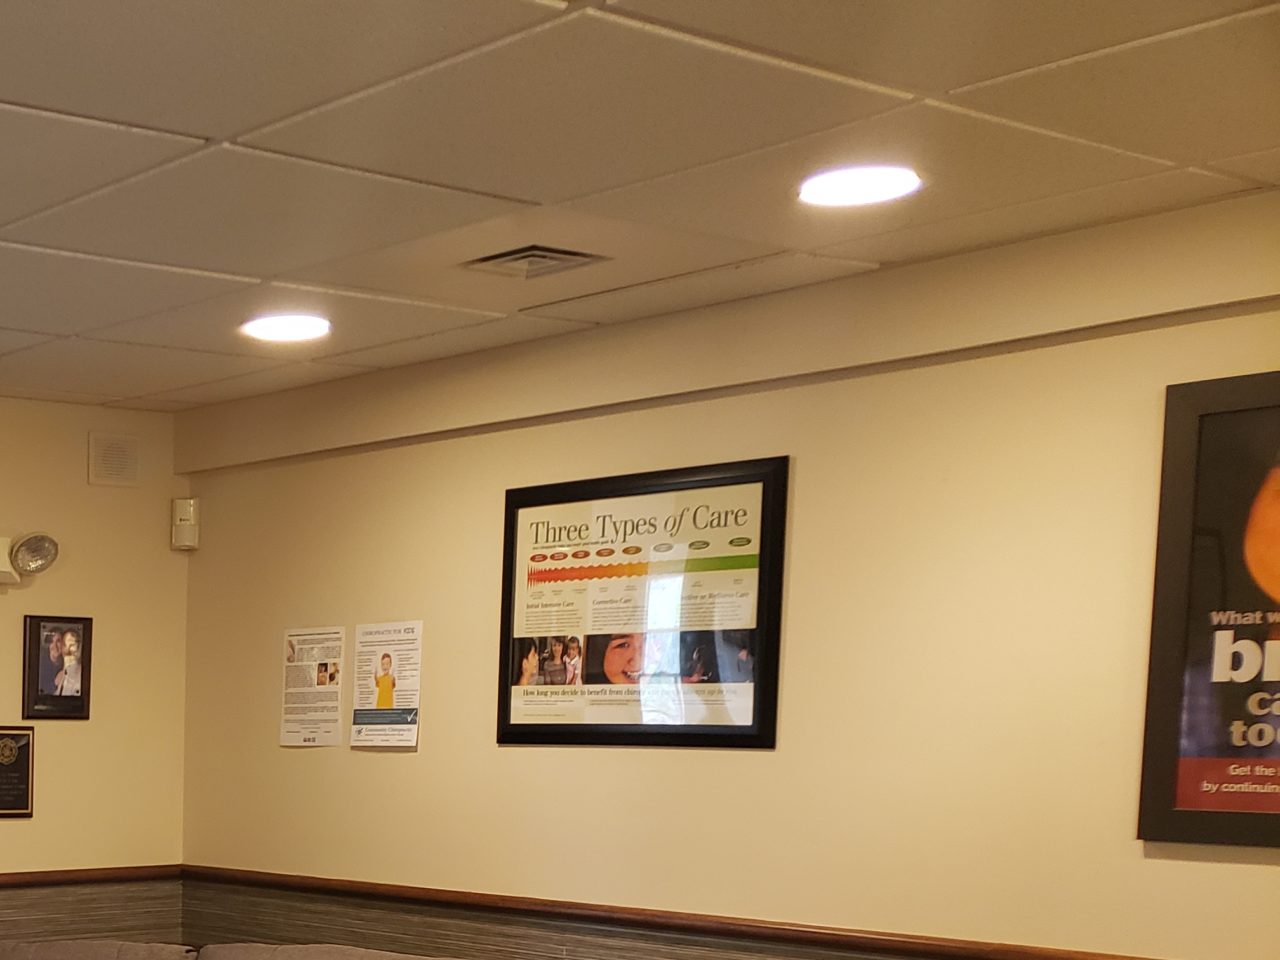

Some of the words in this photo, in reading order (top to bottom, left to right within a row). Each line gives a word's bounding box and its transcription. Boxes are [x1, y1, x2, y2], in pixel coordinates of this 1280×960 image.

[529, 520, 590, 545] Three
[596, 514, 657, 544] Types
[663, 507, 690, 537] of
[692, 504, 748, 530] Care
[1209, 610, 1264, 625] What
[536, 689, 549, 698] long
[549, 690, 560, 698] you
[587, 688, 607, 696] benefit
[609, 688, 623, 696] from
[1229, 764, 1251, 776] Get
[1254, 765, 1276, 776] the
[1202, 780, 1220, 793] by
